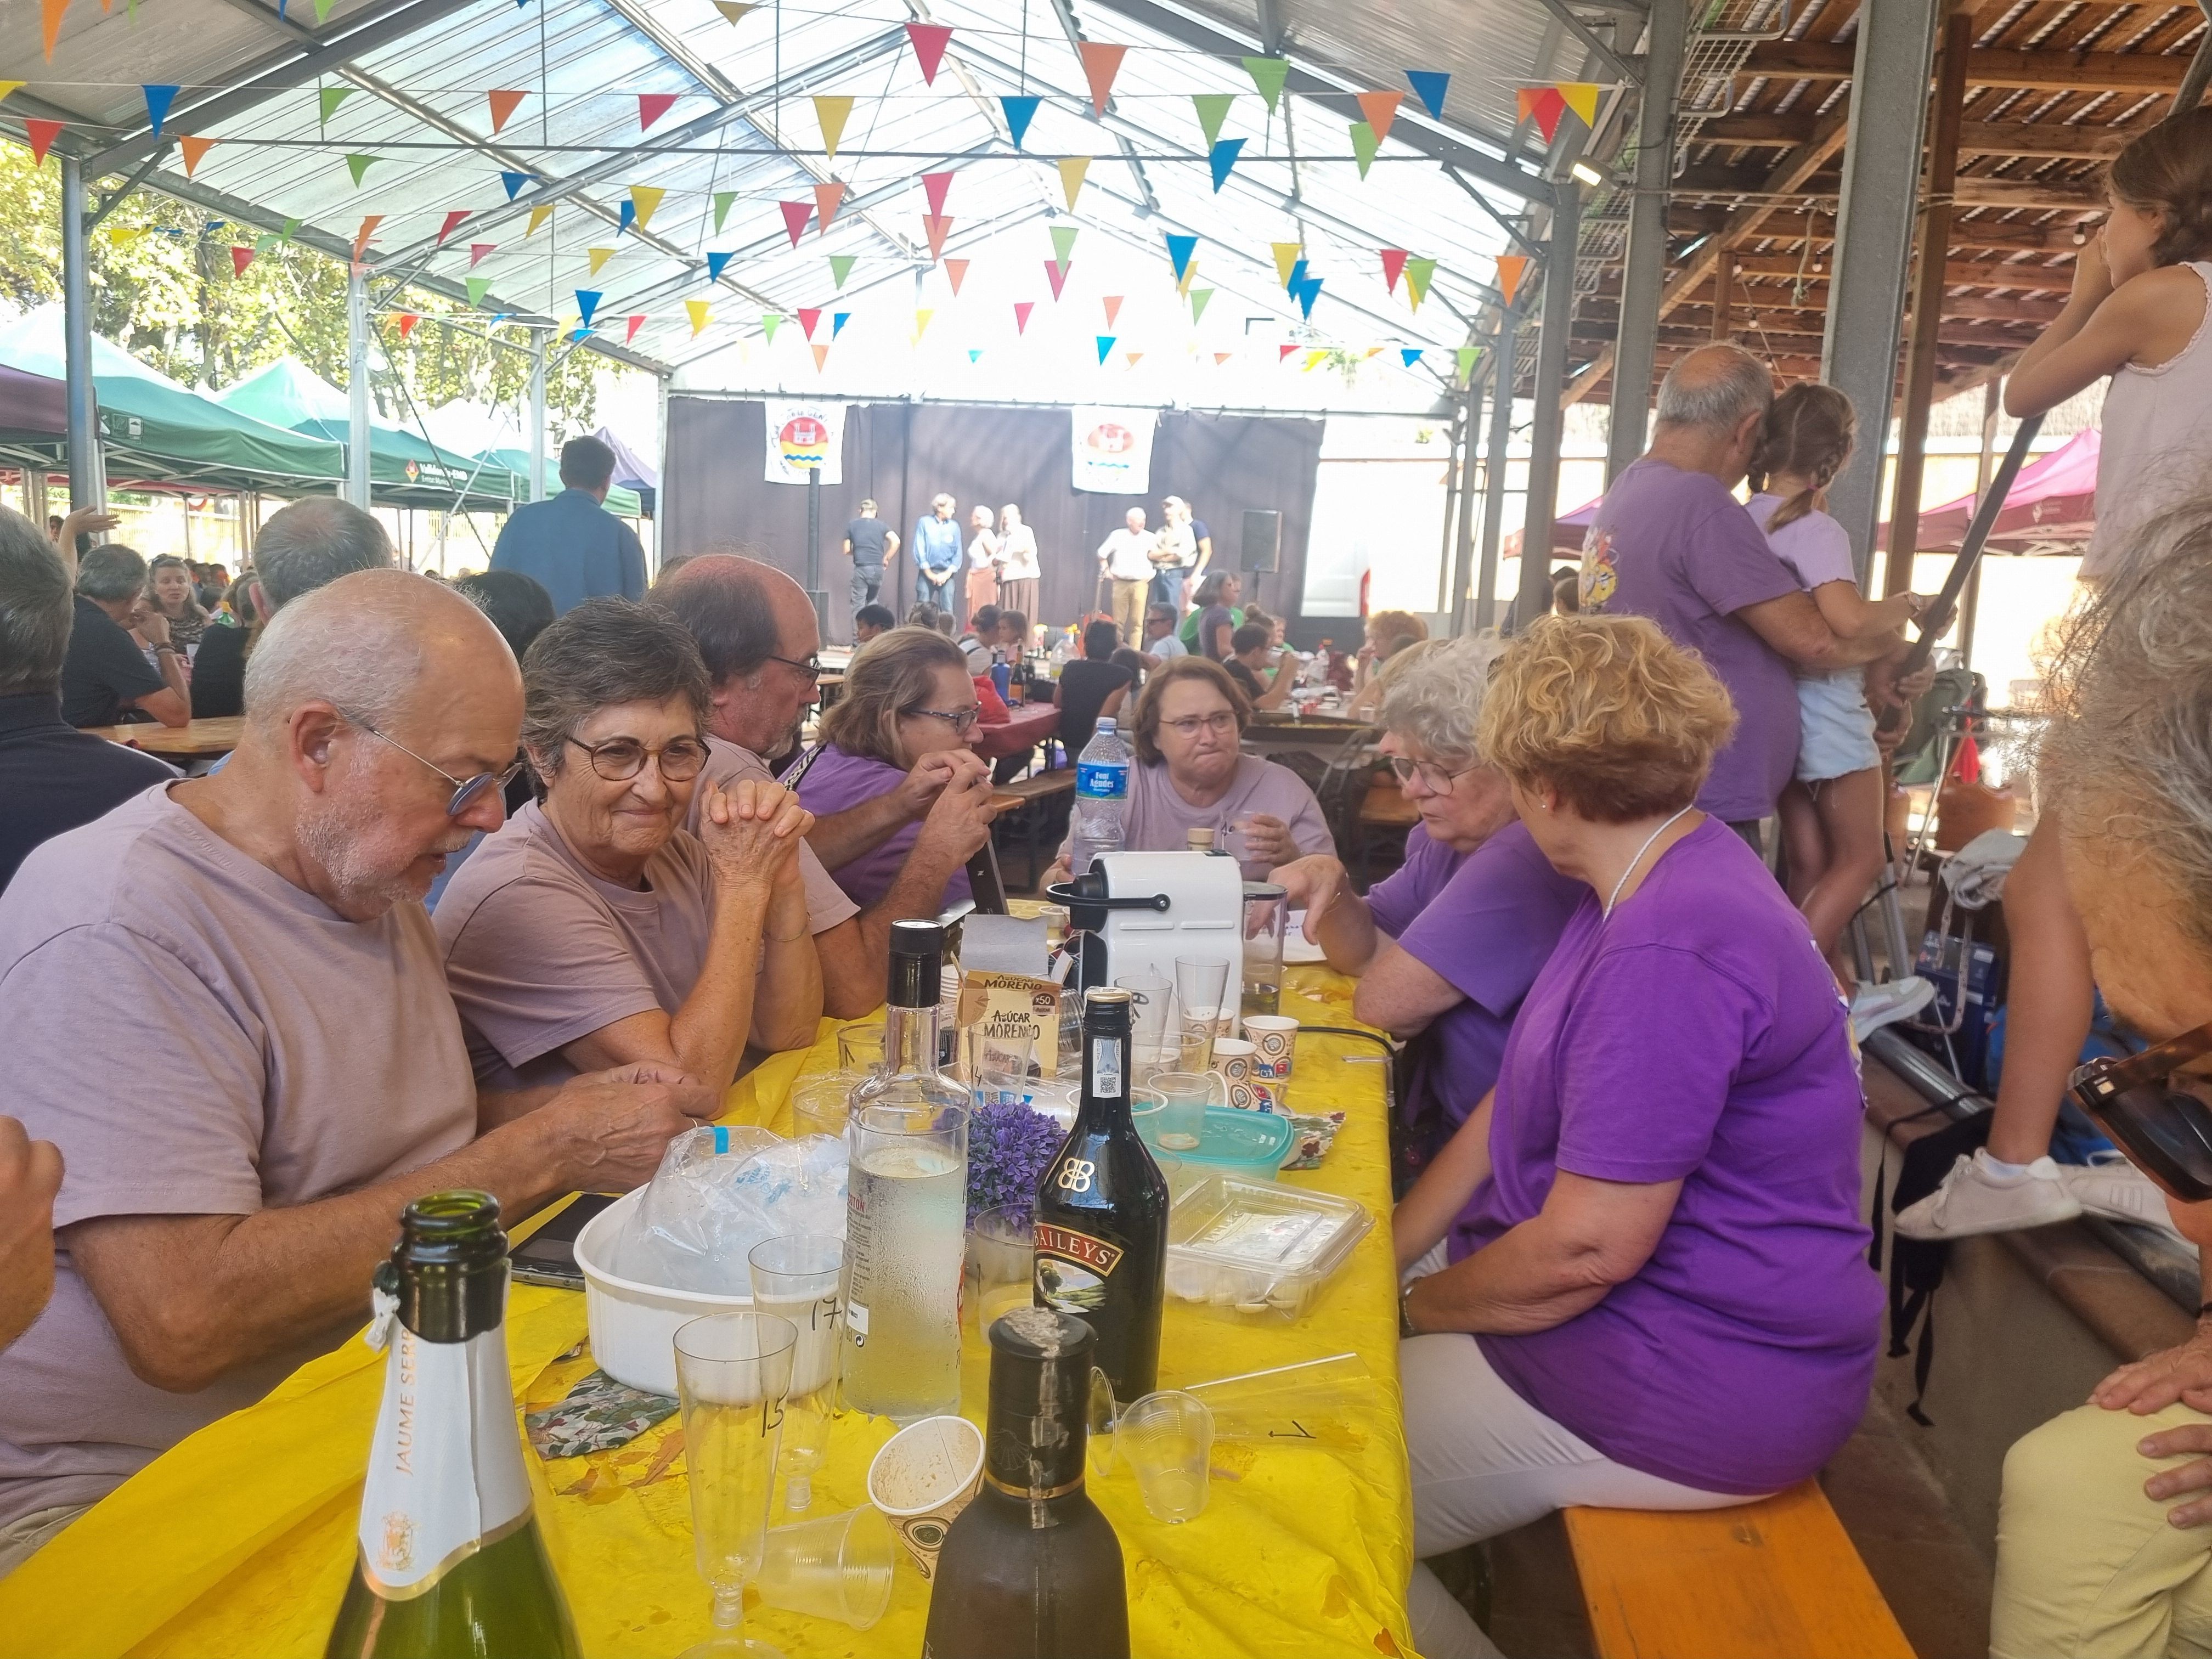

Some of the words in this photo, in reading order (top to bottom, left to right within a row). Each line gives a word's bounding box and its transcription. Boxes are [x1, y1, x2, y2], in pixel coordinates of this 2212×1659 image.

[1090, 778, 1114, 788] Agudes
[984, 979, 1042, 990] MORENO
[1036, 996, 1051, 1005] x50
[984, 1023, 1040, 1040] MORENO
[1034, 1229, 1111, 1265] BAILEYS
[812, 1297, 843, 1331] 17
[401, 1328, 416, 1385] SERR
[761, 1386, 790, 1438] 15
[396, 1392, 414, 1477] JAUME
